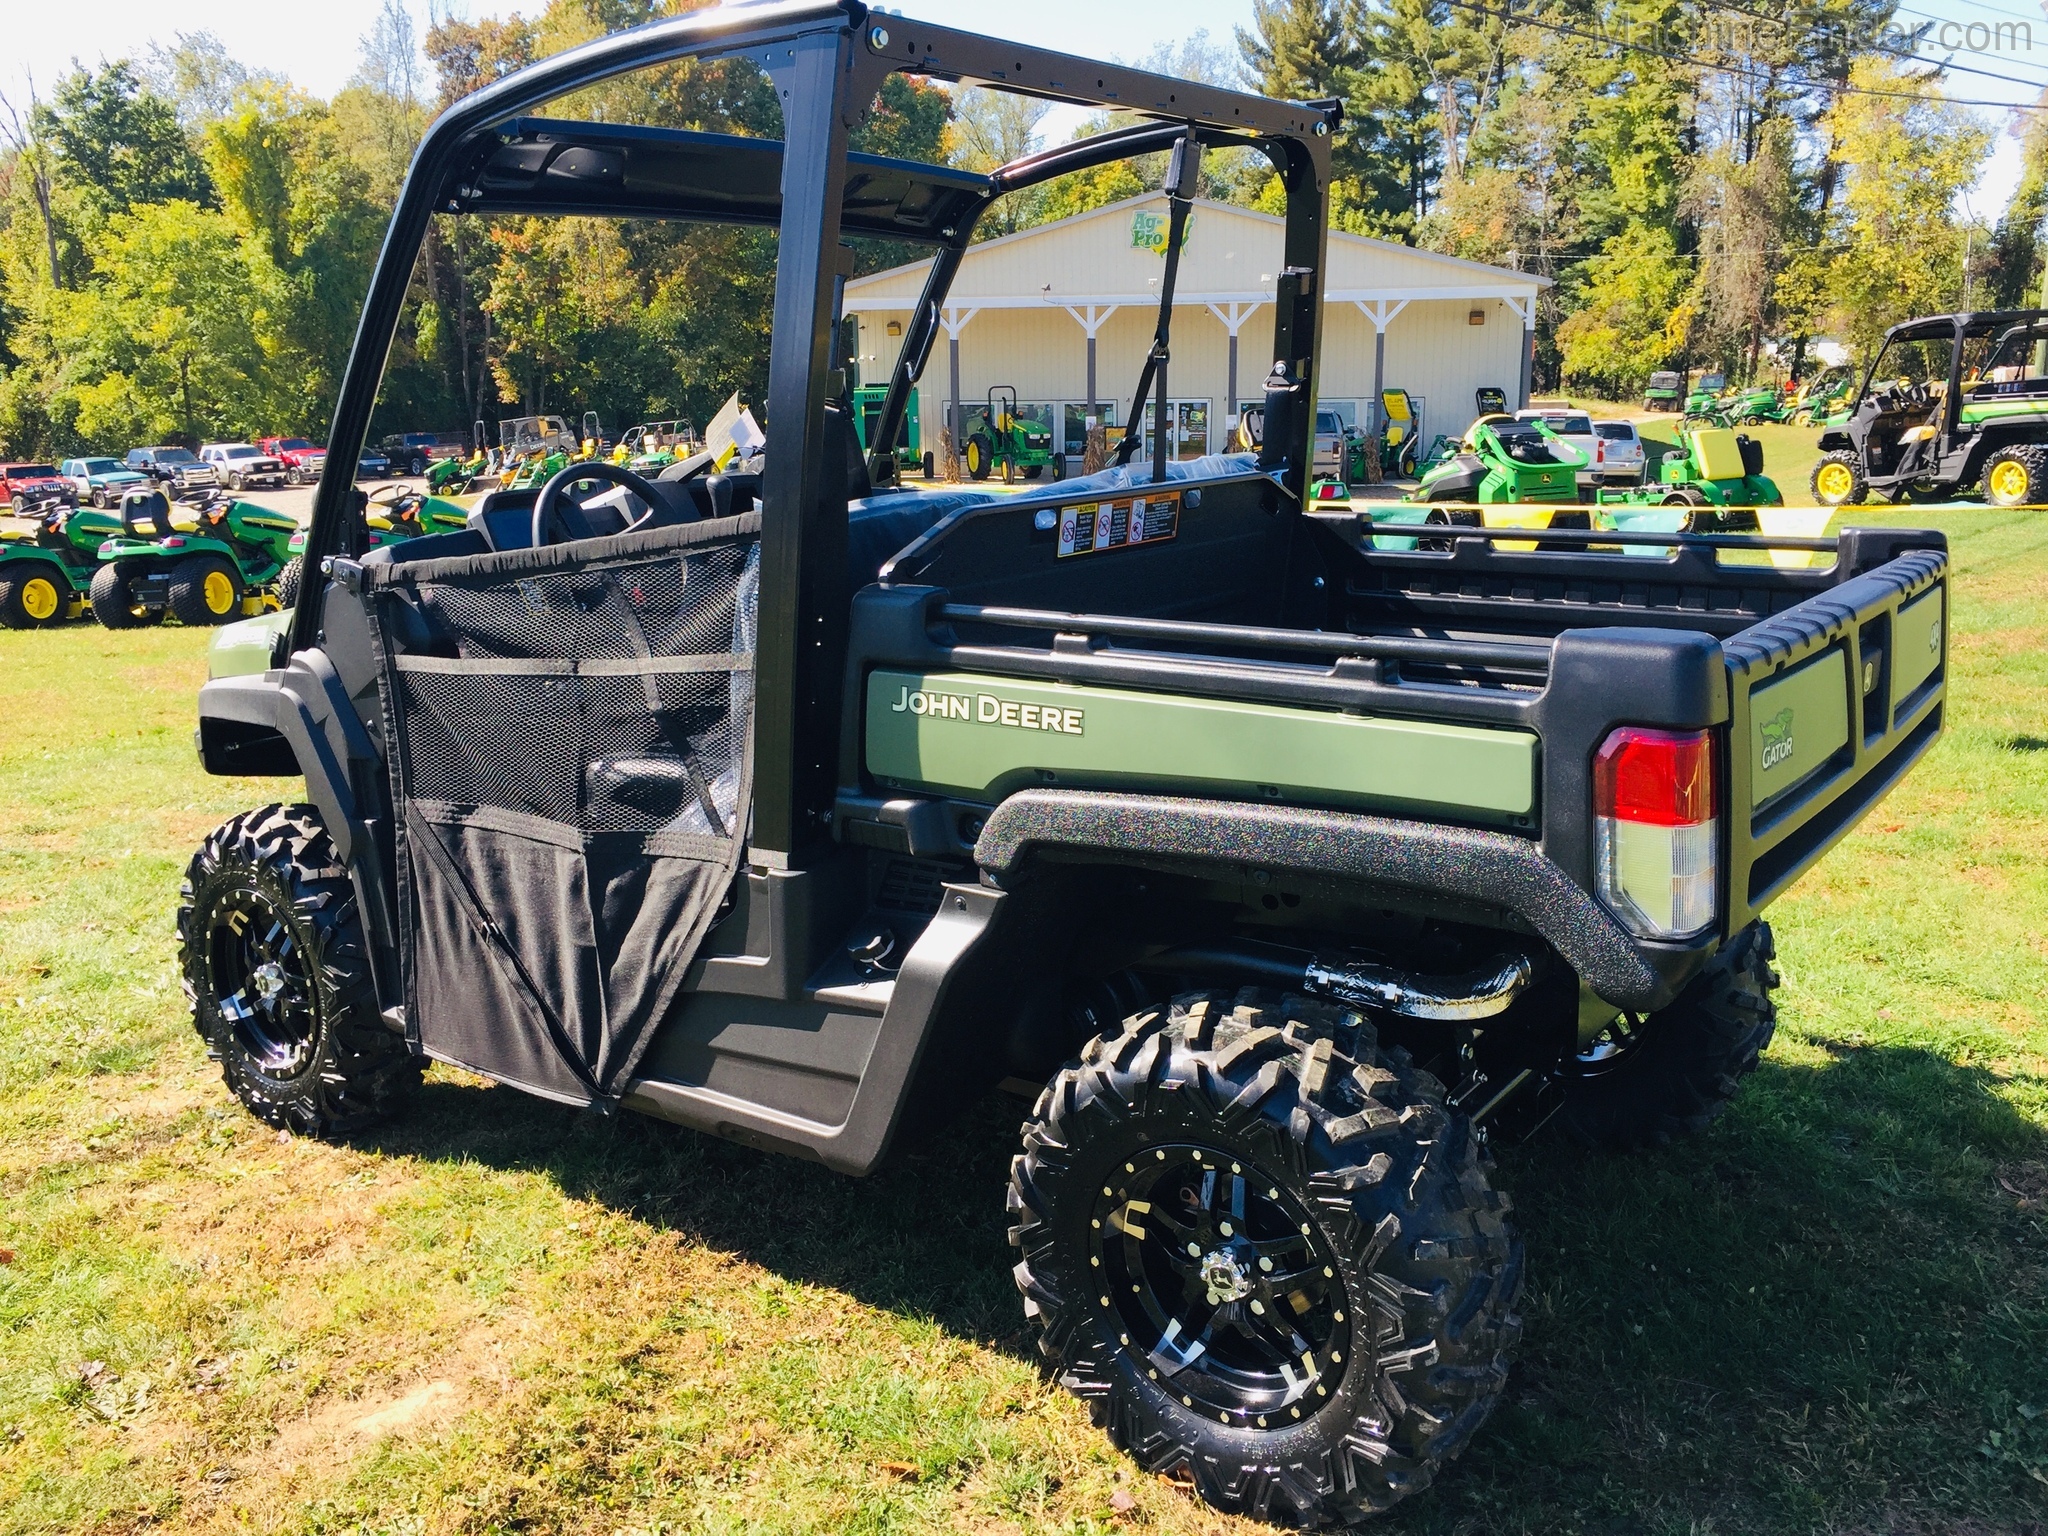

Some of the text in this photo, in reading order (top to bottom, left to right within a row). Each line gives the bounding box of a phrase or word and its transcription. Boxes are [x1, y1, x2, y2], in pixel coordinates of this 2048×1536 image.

[1133, 213, 1163, 233] Ag-
[1133, 231, 1163, 247] Pro
[892, 686, 1084, 735] JOHN DEERE
[1762, 736, 1793, 769] GATOR
